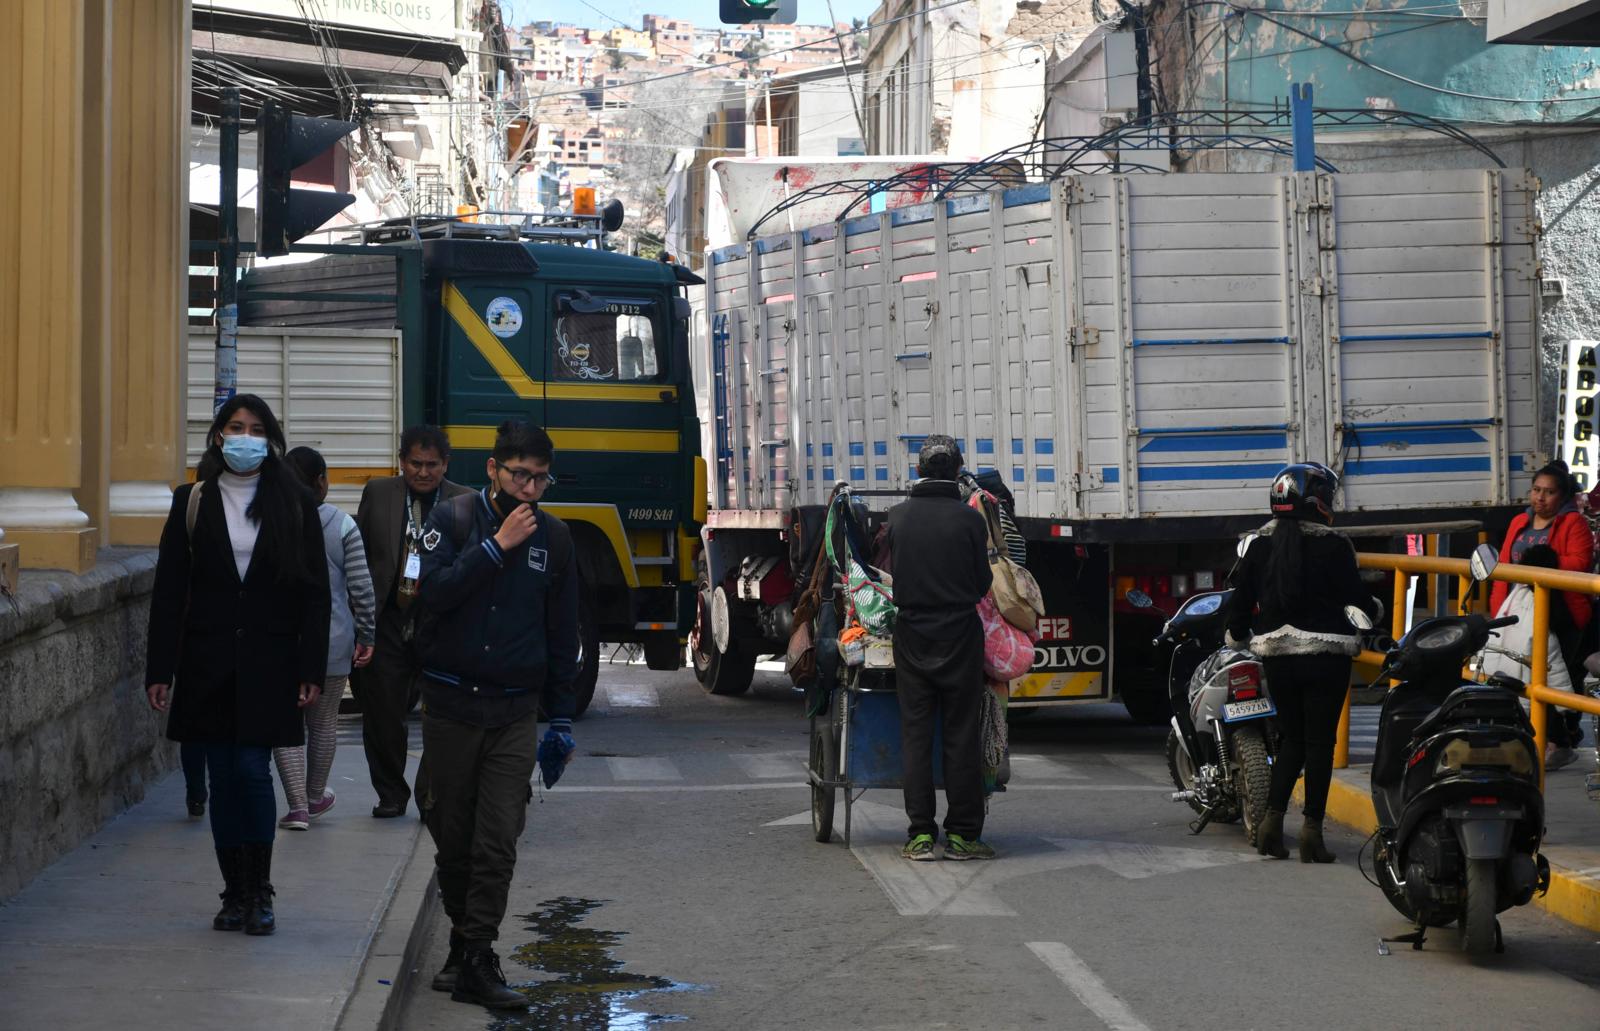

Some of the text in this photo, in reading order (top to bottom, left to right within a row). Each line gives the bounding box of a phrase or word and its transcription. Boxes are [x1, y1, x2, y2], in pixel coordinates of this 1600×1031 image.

[337, 0, 432, 20] INVERSIONES
[621, 304, 640, 314] F12
[1557, 344, 1569, 461] ABOGA
[1570, 345, 1597, 493] ABOGAD
[628, 508, 652, 520] 1499
[1039, 618, 1070, 639] F12
[1032, 645, 1106, 667] OLVO
